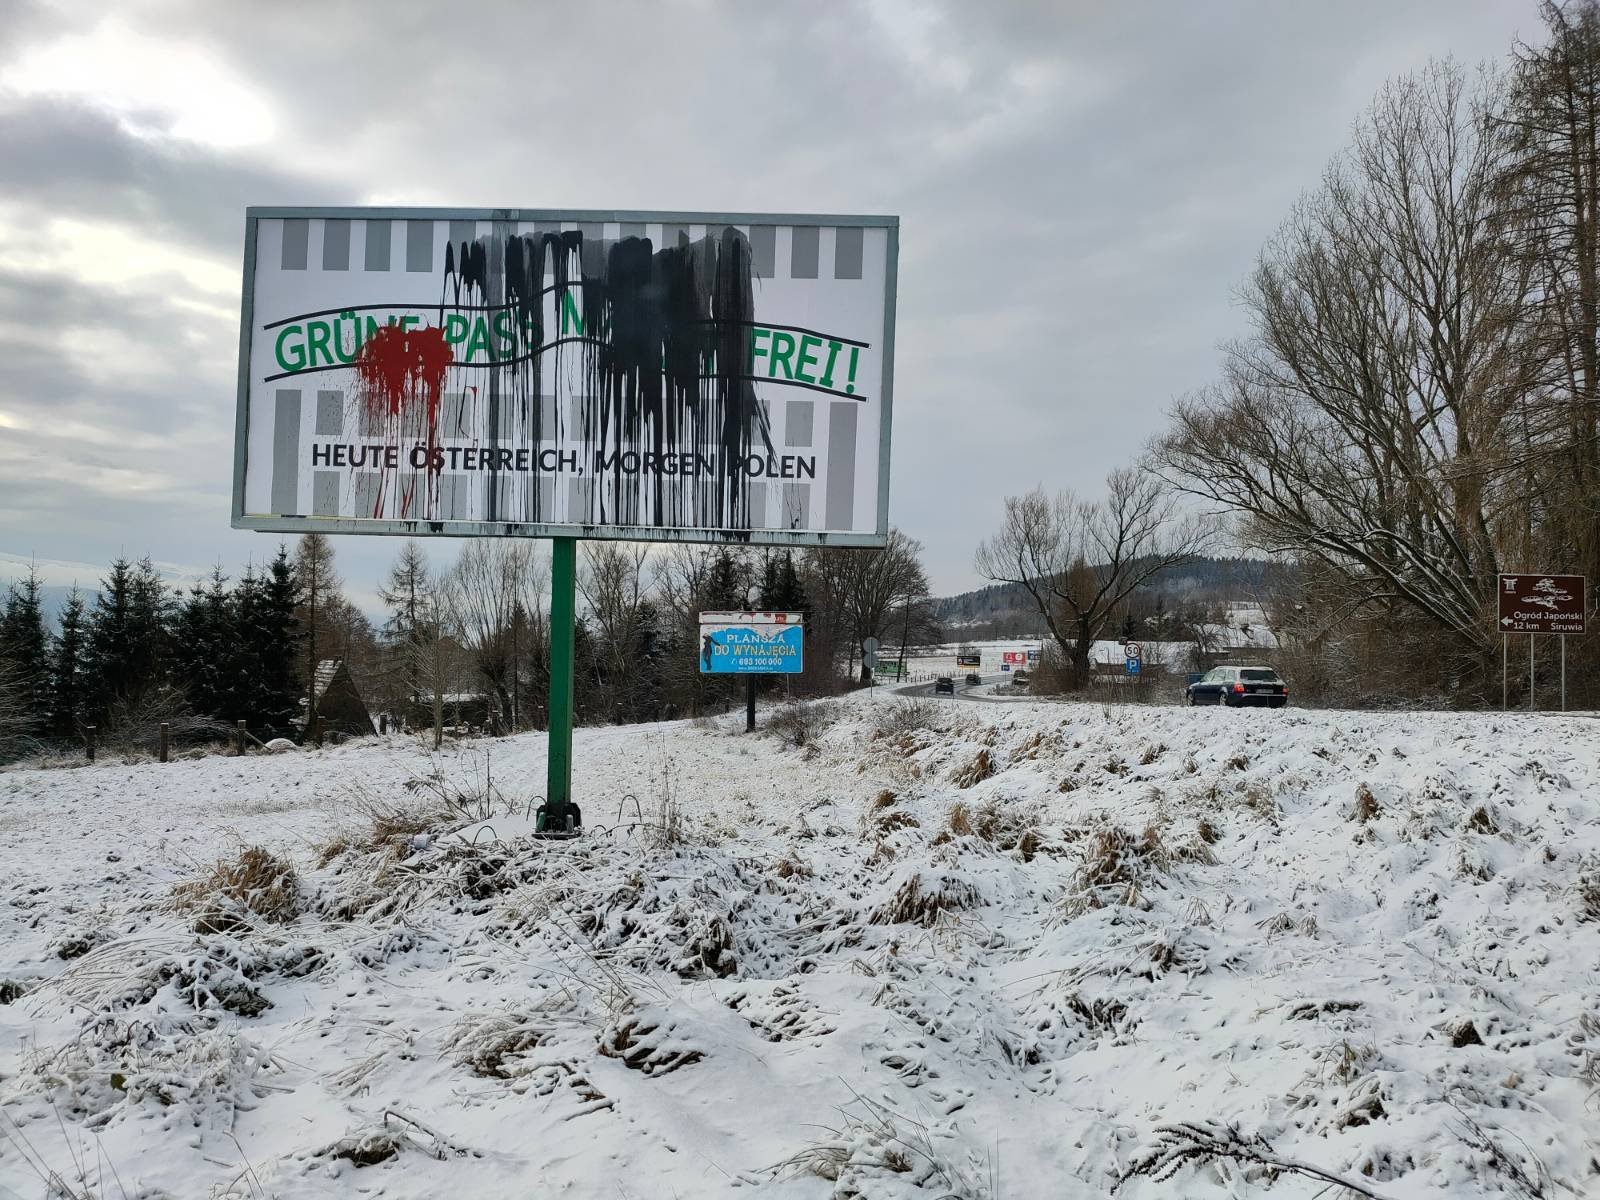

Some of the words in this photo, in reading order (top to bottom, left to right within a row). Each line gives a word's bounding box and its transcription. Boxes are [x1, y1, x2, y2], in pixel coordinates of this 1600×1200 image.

[743, 327, 861, 395] FREI!
[311, 443, 399, 469] HEUTE
[408, 440, 585, 476] ÖSTERREICH,
[594, 449, 716, 478] MORGEN
[1513, 611, 1542, 622] Ogród
[1544, 611, 1583, 622] Japoński
[1513, 622, 1525, 630] 12
[1526, 621, 1540, 630] km
[1551, 622, 1583, 631] Siruwia
[727, 634, 786, 644] PLANSZA
[714, 645, 730, 656] DO
[1127, 647, 1139, 655] 50
